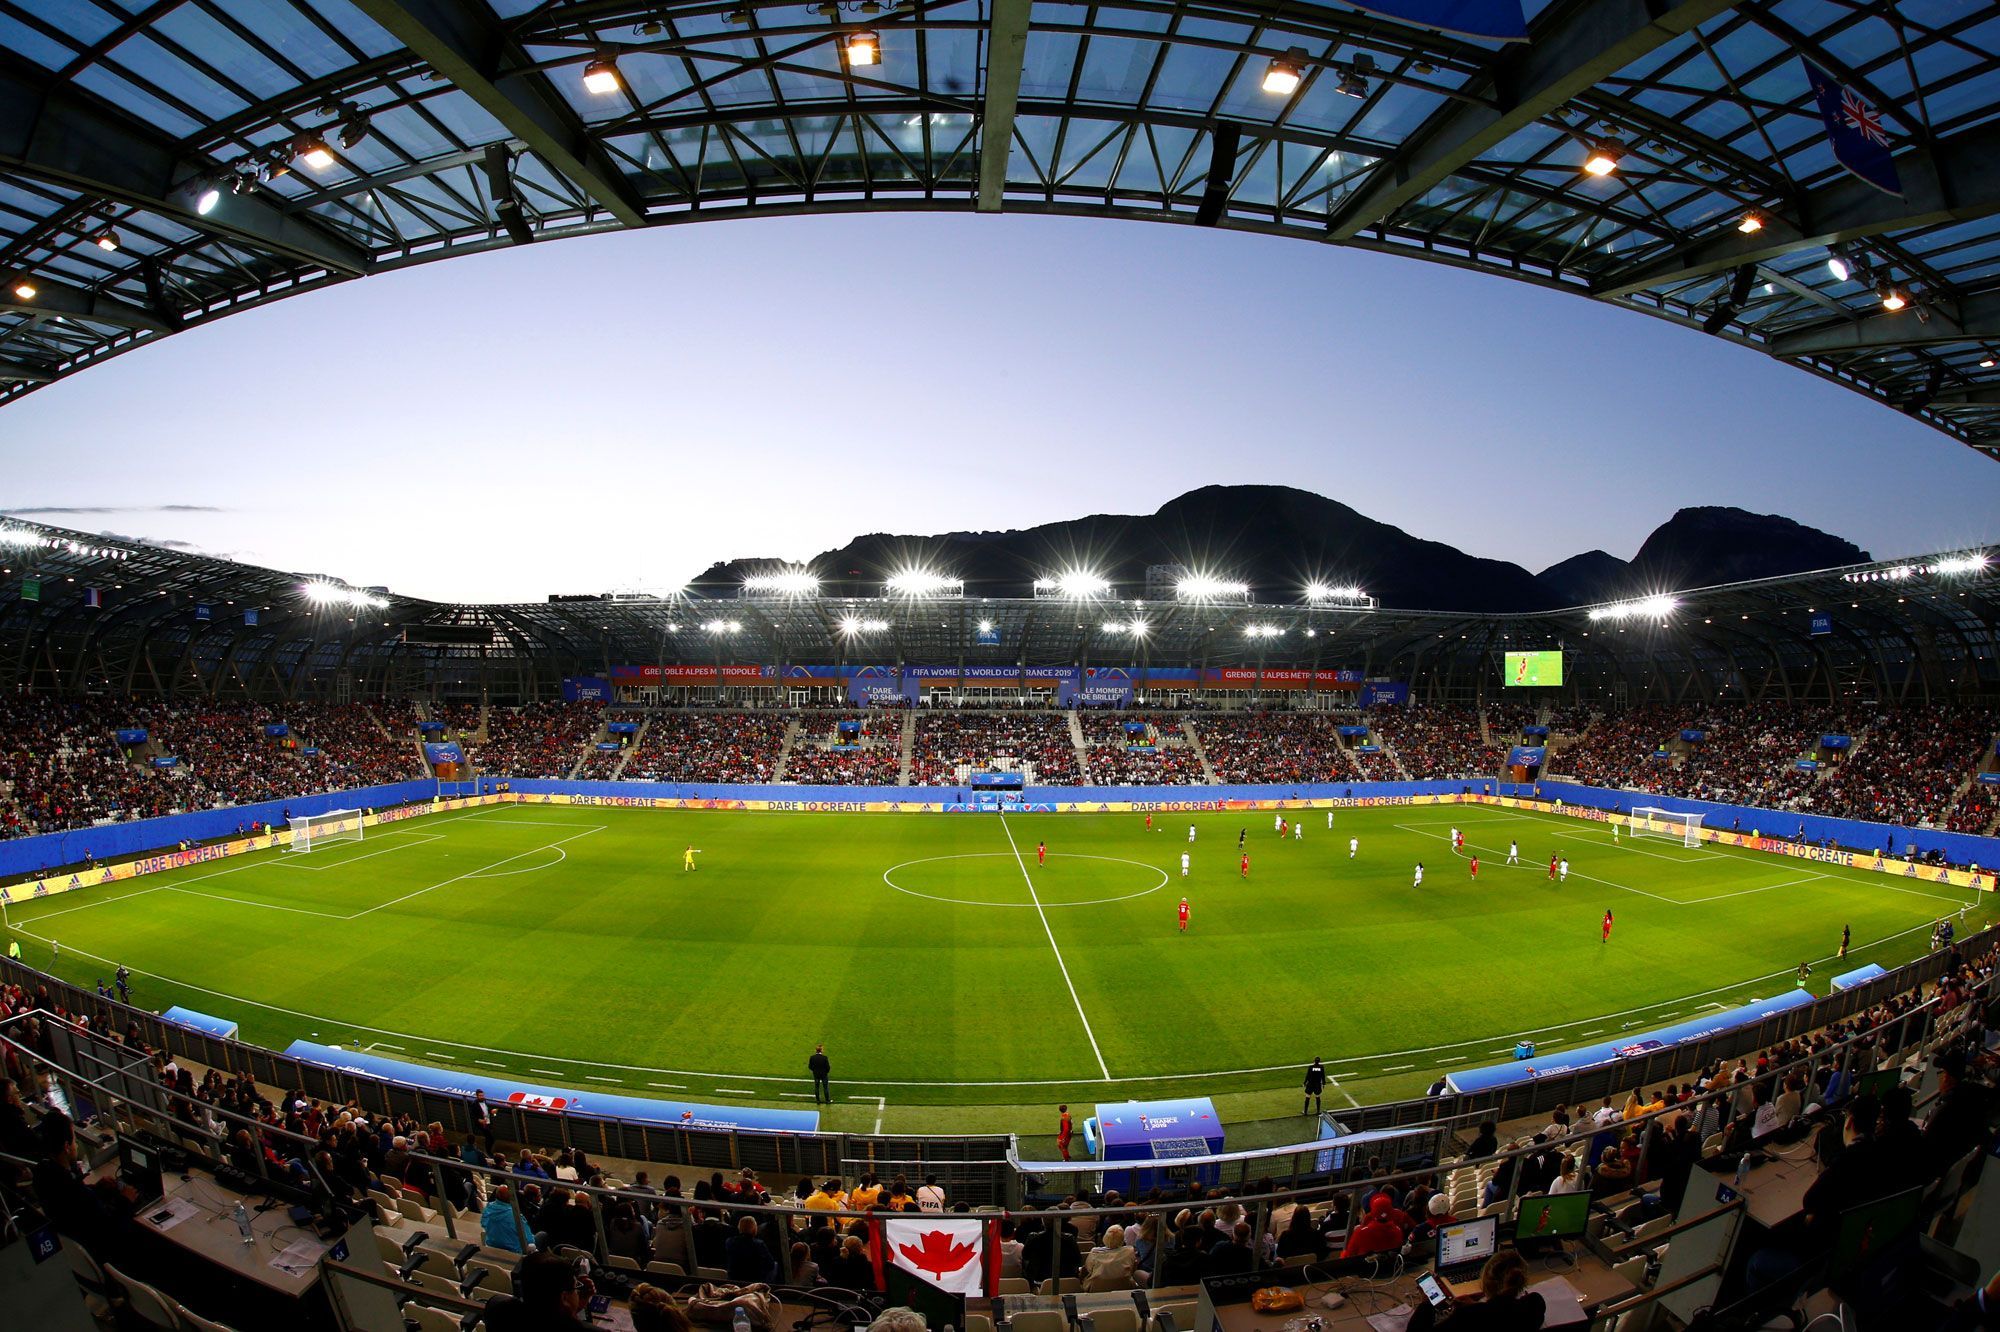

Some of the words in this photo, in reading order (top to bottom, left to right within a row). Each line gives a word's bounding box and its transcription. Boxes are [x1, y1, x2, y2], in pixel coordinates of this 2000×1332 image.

[1812, 619, 1828, 628] FIFA
[913, 668, 929, 676] FIFA
[971, 668, 1002, 676] WORLD
[1003, 668, 1020, 676] CUP
[1054, 669, 1073, 677] 2019
[1225, 671, 1265, 679] GRENOBE
[1266, 671, 1289, 679] ALPES
[867, 693, 879, 701] TO
[880, 693, 904, 701] SHINE
[570, 796, 596, 805] DARE
[599, 796, 613, 806] TO
[615, 797, 657, 807] CREATE
[768, 801, 797, 811] DARE
[801, 802, 817, 811] TO
[821, 802, 866, 812] CREATE
[1131, 802, 1162, 812] DARE
[1165, 802, 1181, 811] TO
[1332, 797, 1358, 807] DARE
[1362, 797, 1375, 806] TO
[1378, 796, 1414, 806] CREATE
[377, 809, 397, 823] DARE
[397, 807, 409, 820] TO
[409, 803, 433, 819] CREATE
[1551, 804, 1568, 815] DARE
[1570, 806, 1581, 817] TO
[1582, 808, 1610, 823] CREATE
[1760, 838, 1788, 855] DARE
[1791, 843, 1807, 858] TO
[1809, 845, 1853, 866] CREATE
[135, 856, 167, 876] DARE
[168, 852, 186, 868] TO
[187, 843, 230, 864] CREATE
[921, 1201, 940, 1209] FIFA
